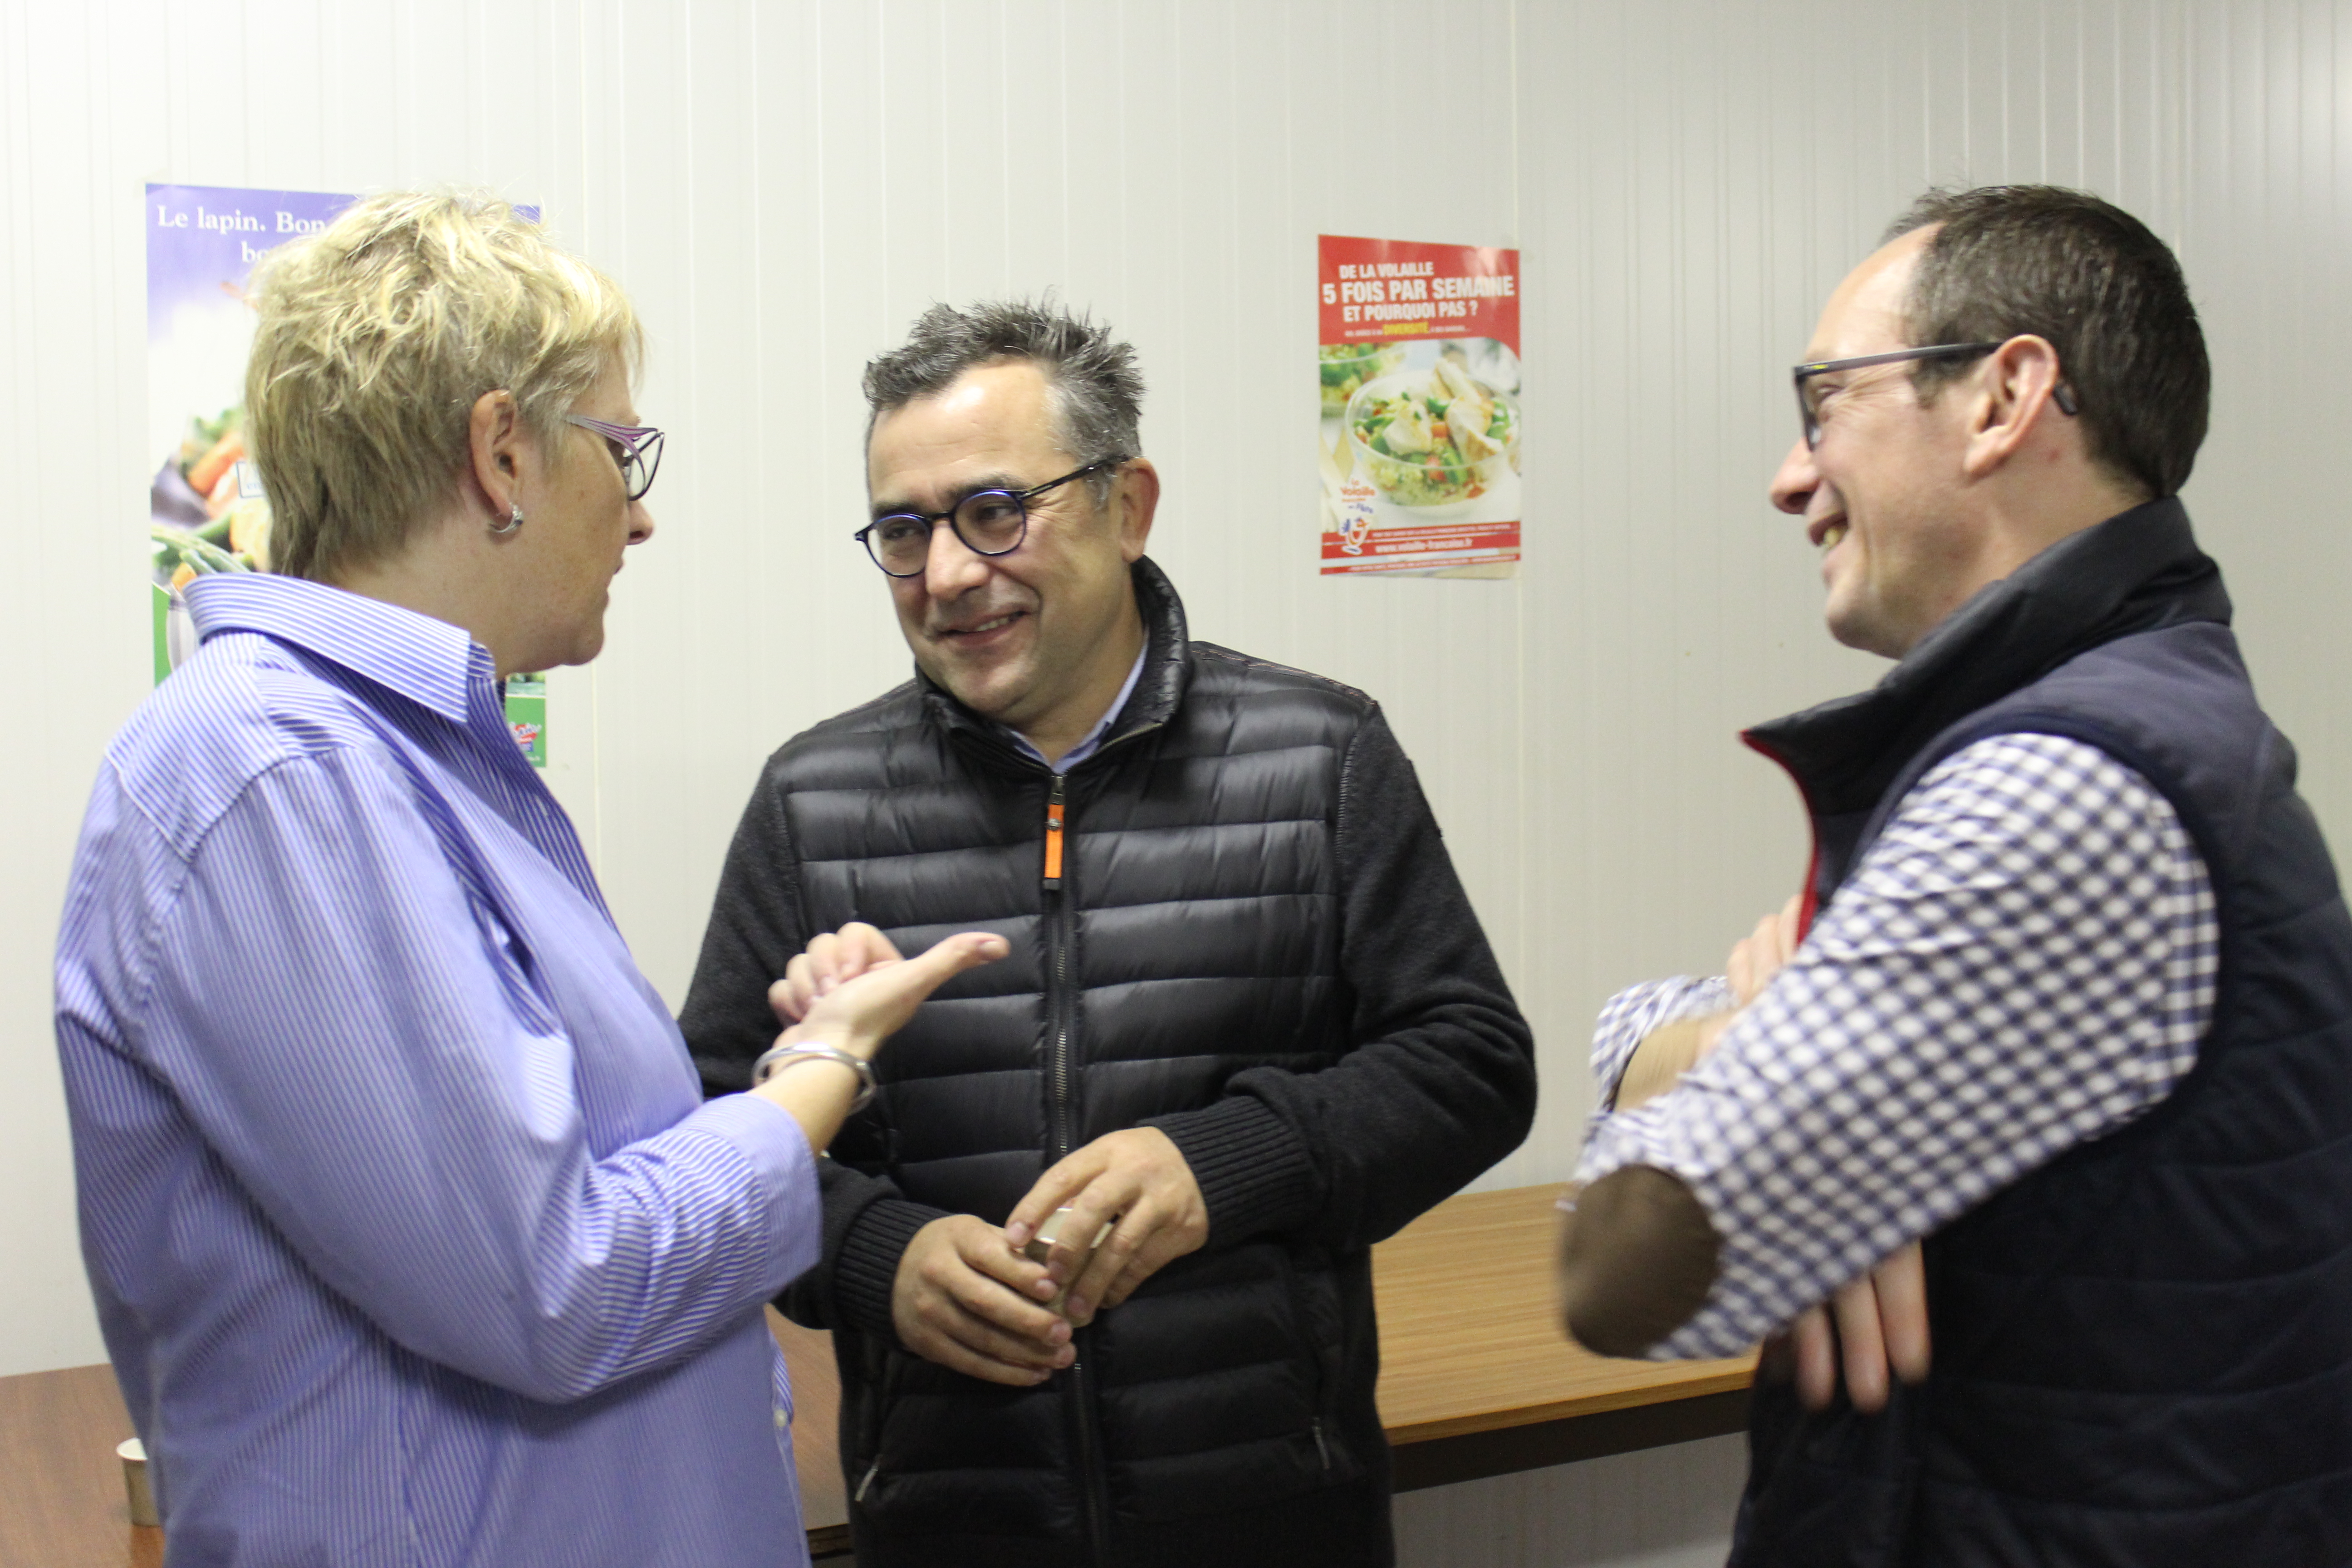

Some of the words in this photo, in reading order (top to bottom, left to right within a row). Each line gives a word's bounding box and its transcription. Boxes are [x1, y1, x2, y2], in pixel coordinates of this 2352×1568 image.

[157, 205, 188, 228] Le
[197, 206, 266, 235] lapin.
[1339, 265, 1357, 279] DE
[1360, 264, 1376, 278] LA
[1377, 262, 1434, 277] VOLAILLE
[1323, 283, 1336, 304] 5
[1341, 281, 1385, 303] FOIS
[1389, 279, 1428, 301] PAR
[1432, 275, 1515, 299] SEMAINE
[1343, 306, 1361, 322] ET
[1364, 303, 1436, 321] POURQUOI
[1439, 301, 1466, 317] PAS
[1469, 300, 1479, 316] ?
